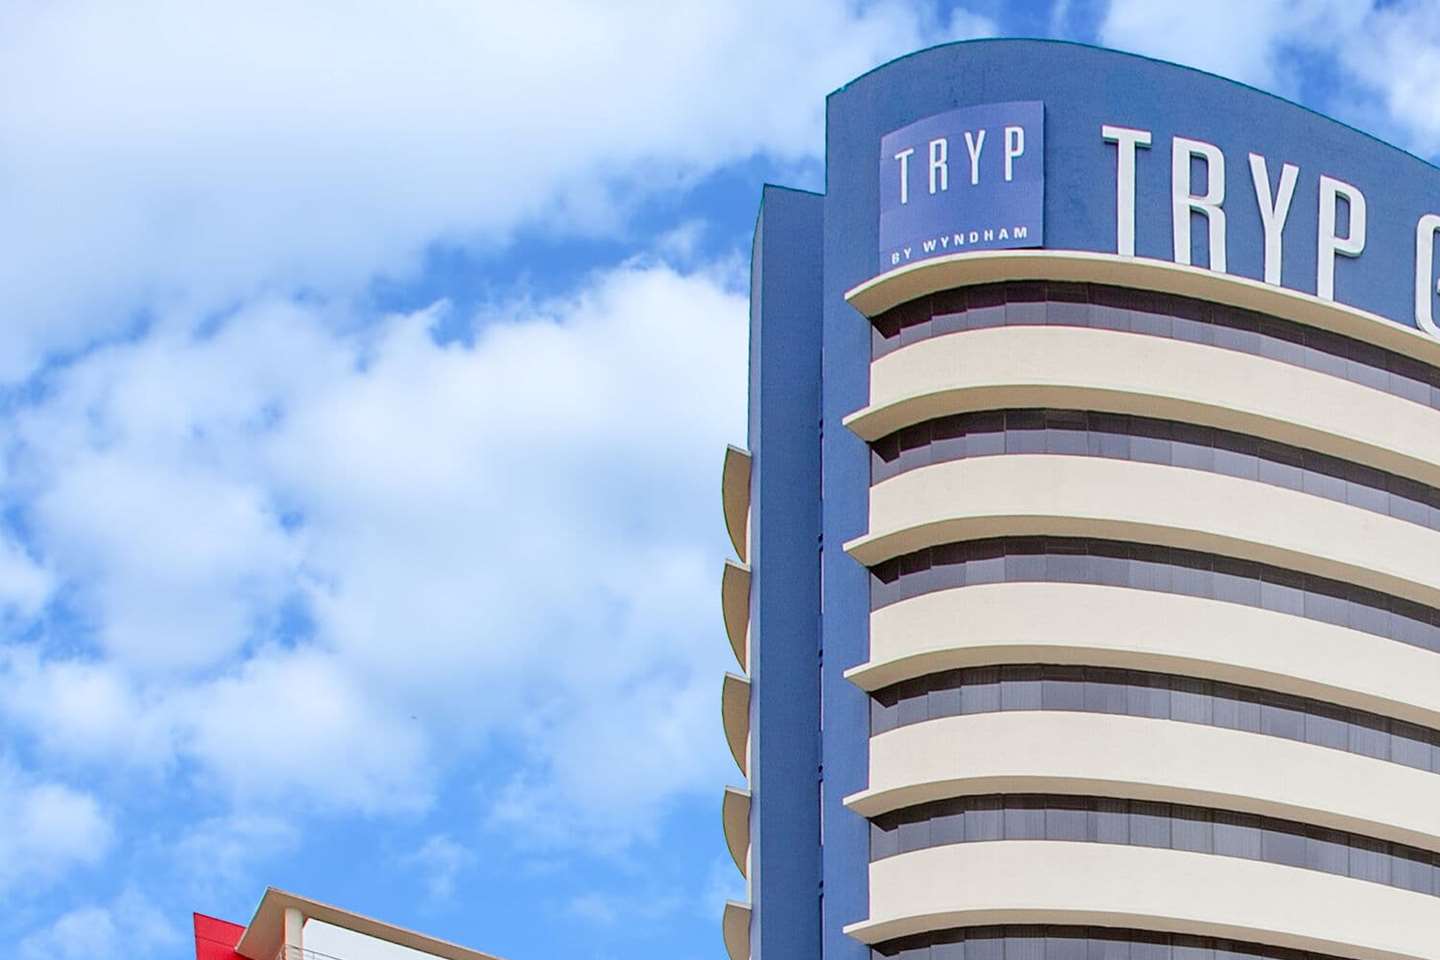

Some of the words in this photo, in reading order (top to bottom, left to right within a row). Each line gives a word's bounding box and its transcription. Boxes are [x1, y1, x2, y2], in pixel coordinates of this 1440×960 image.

[894, 126, 1025, 204] TRYP
[891, 247, 912, 265] BY
[923, 226, 1028, 253] WYNDHAM
[1102, 125, 1366, 301] TRYP
